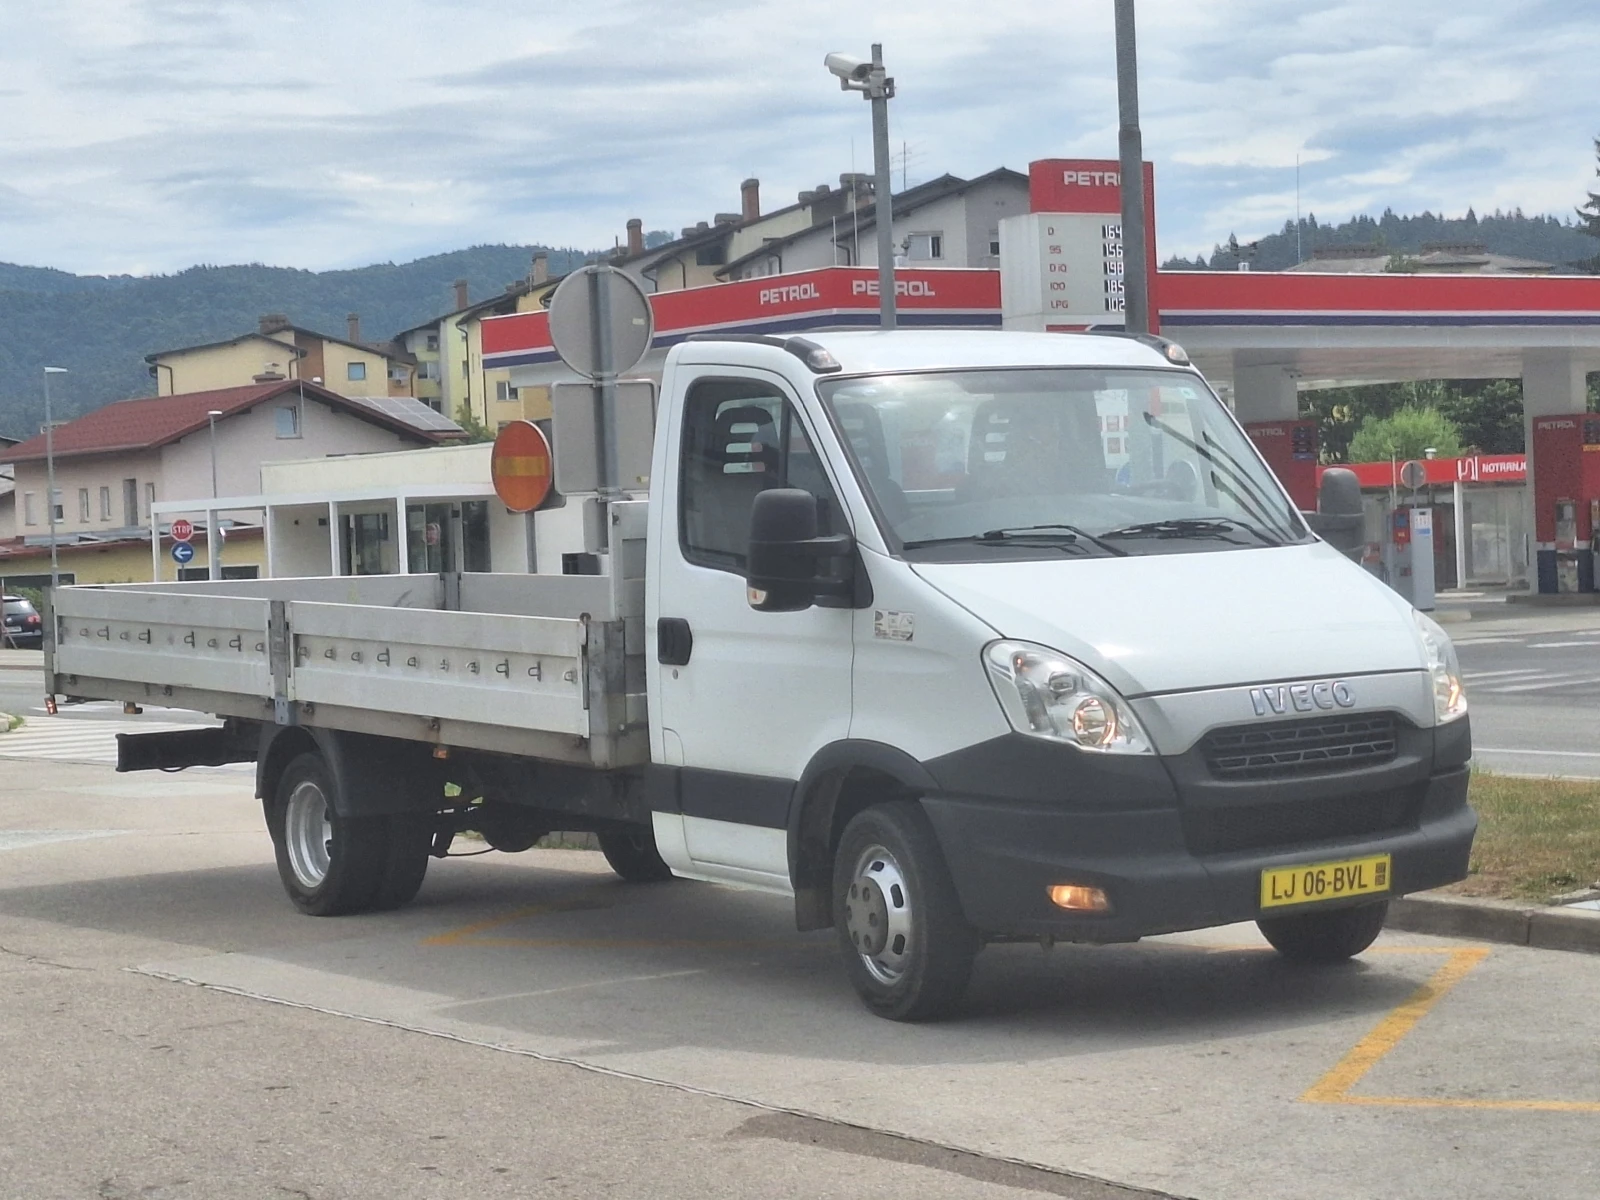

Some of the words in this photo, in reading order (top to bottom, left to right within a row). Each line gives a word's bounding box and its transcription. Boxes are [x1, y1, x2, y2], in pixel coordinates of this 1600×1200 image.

[1063, 171, 1121, 186] PETR
[1048, 227, 1054, 235] D
[1049, 245, 1062, 254] 95
[1049, 263, 1056, 272] D
[852, 279, 936, 297] PEROL
[1050, 282, 1066, 291] 100
[759, 282, 820, 305] PETROL
[1050, 300, 1069, 309] LPG
[1538, 420, 1576, 429] PETROL
[172, 525, 192, 534] STOP
[1250, 679, 1357, 716] IVECO
[1271, 873, 1296, 900] LJ
[1303, 864, 1368, 897] 06-BVL
